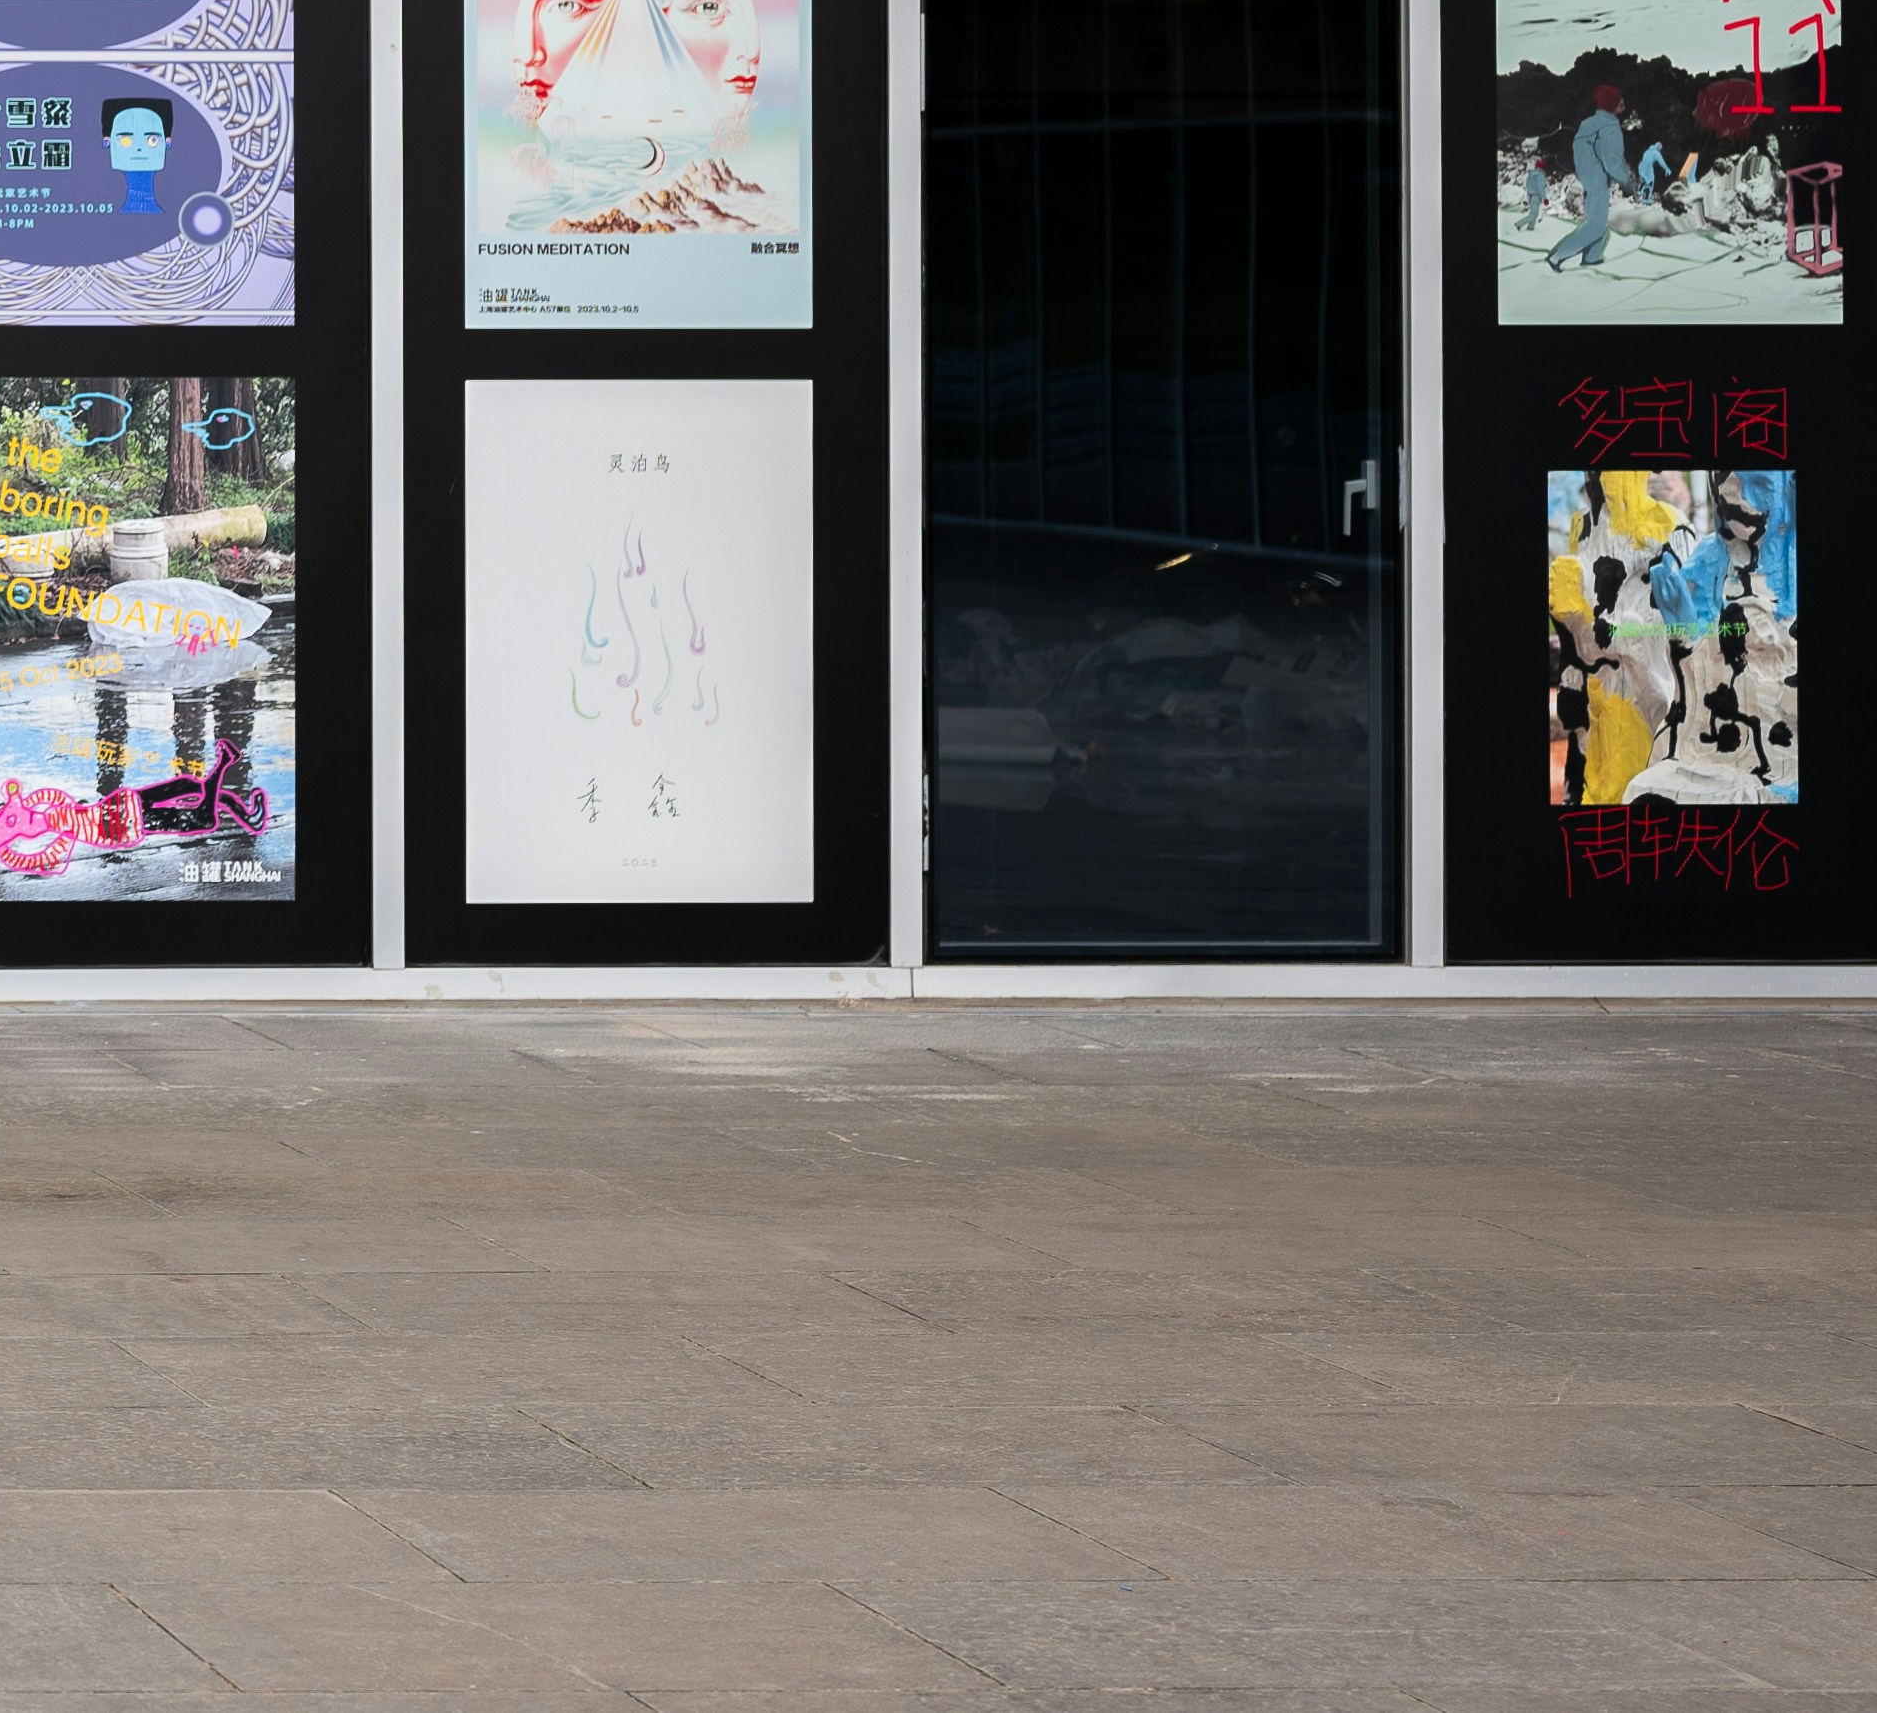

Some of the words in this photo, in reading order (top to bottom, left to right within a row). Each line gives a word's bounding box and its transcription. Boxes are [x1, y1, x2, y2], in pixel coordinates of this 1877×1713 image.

[1724, 14, 1842, 115] 11
[478, 243, 534, 255] FUSION
[537, 243, 630, 255] MEDITATION
[751, 241, 800, 255] 融合冥想
[8, 437, 62, 474] the
[19, 666, 59, 687] Oct
[66, 653, 123, 680] 2023
[179, 861, 221, 882] 油罐
[223, 861, 262, 871] TANK
[224, 871, 281, 882] SHANGHAI
